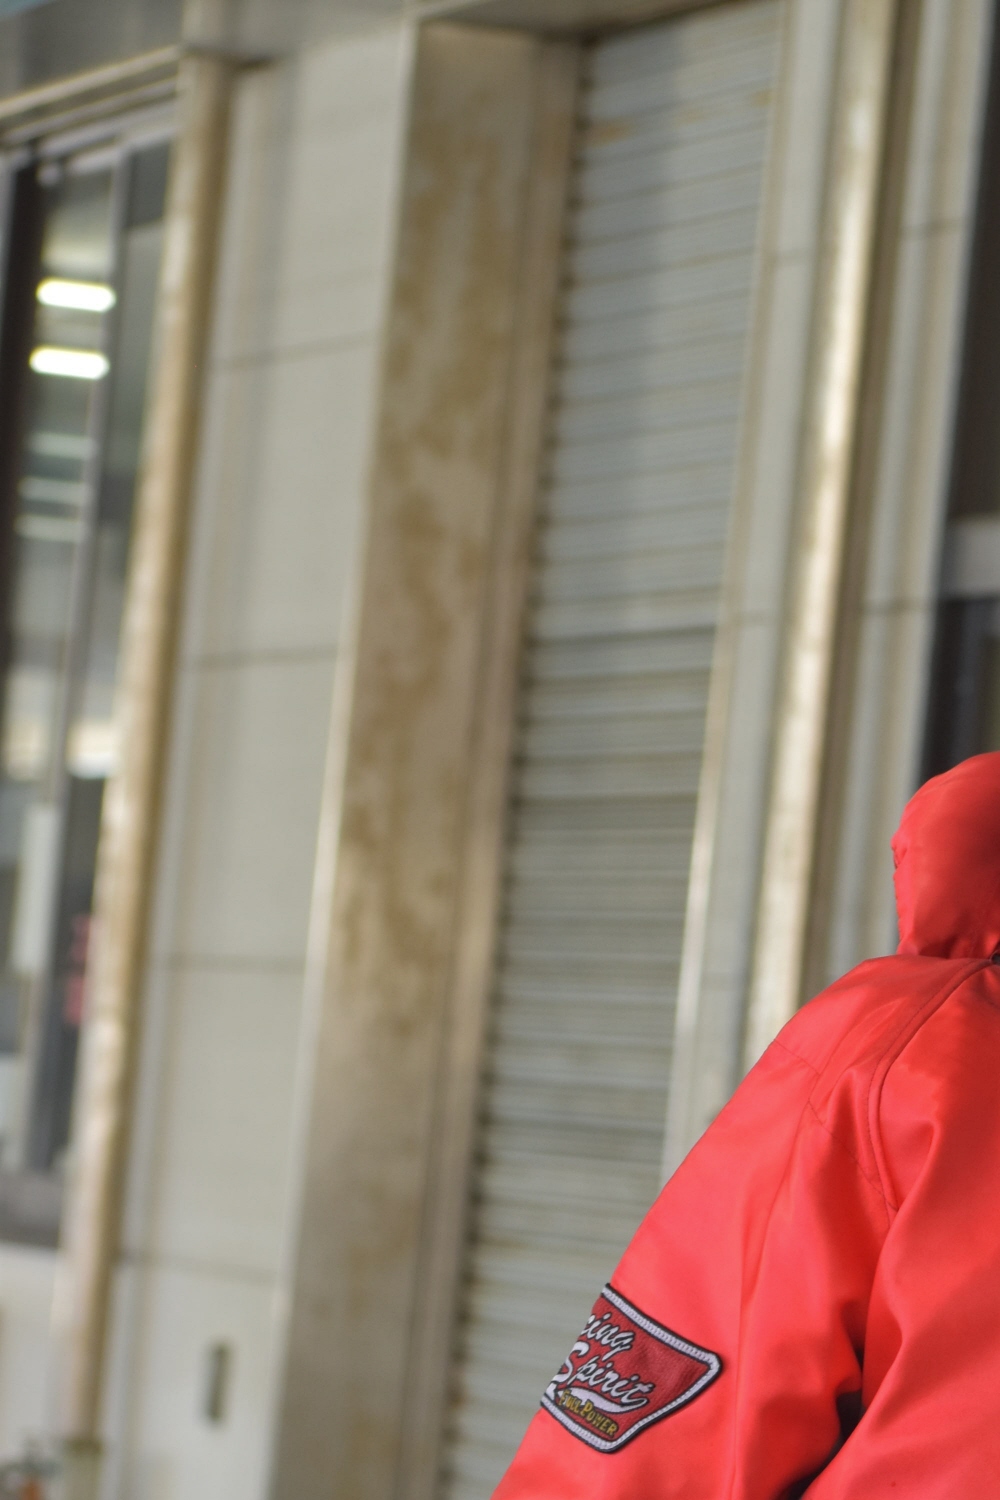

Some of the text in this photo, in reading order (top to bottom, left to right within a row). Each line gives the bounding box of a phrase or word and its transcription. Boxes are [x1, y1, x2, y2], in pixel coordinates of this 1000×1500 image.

[553, 1341, 654, 1405] Spirit
[558, 1389, 619, 1437] FULL POWER
